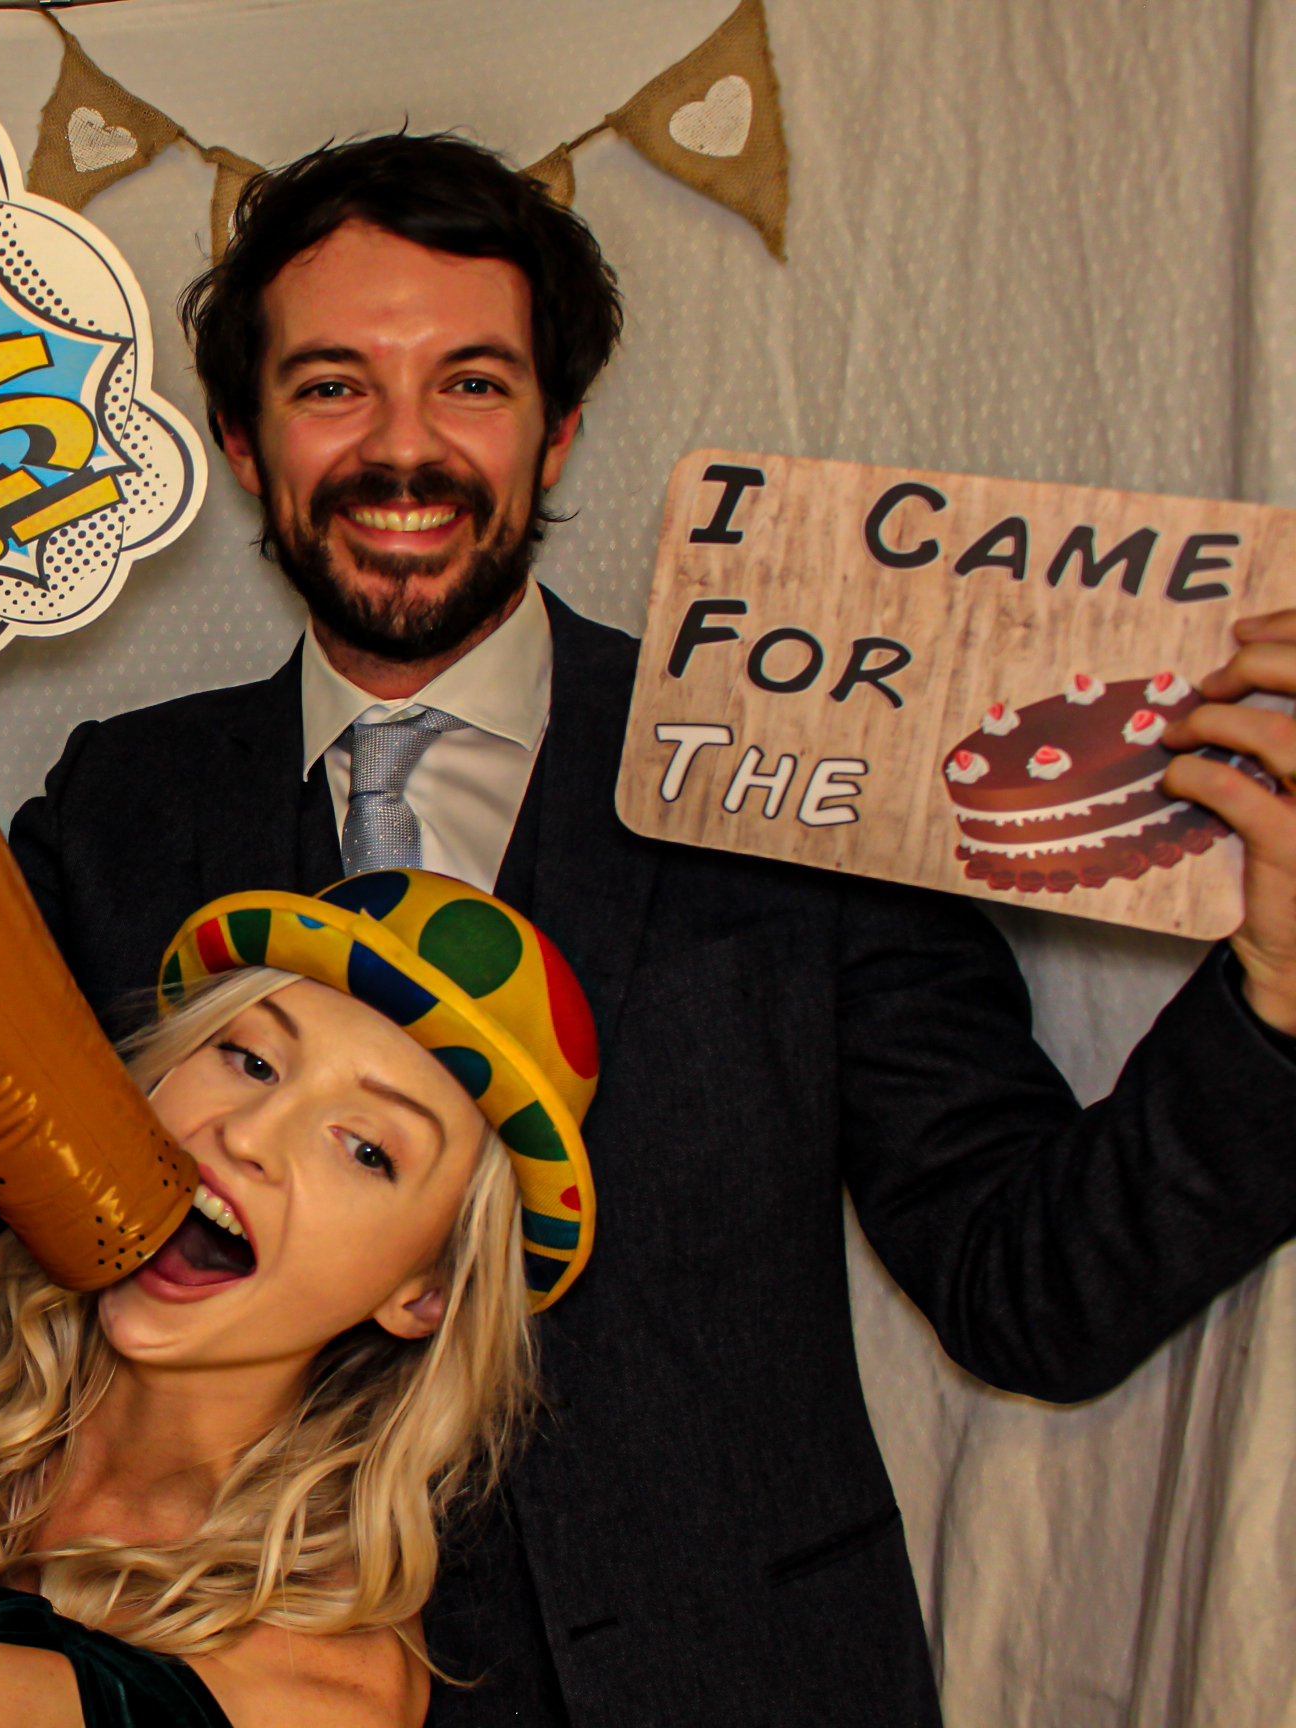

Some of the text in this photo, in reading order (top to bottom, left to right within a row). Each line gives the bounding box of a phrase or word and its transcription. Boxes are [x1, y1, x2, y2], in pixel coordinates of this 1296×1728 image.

[688, 463, 1242, 603] I CAME
[666, 599, 913, 709] FOR
[654, 722, 868, 827] THE
